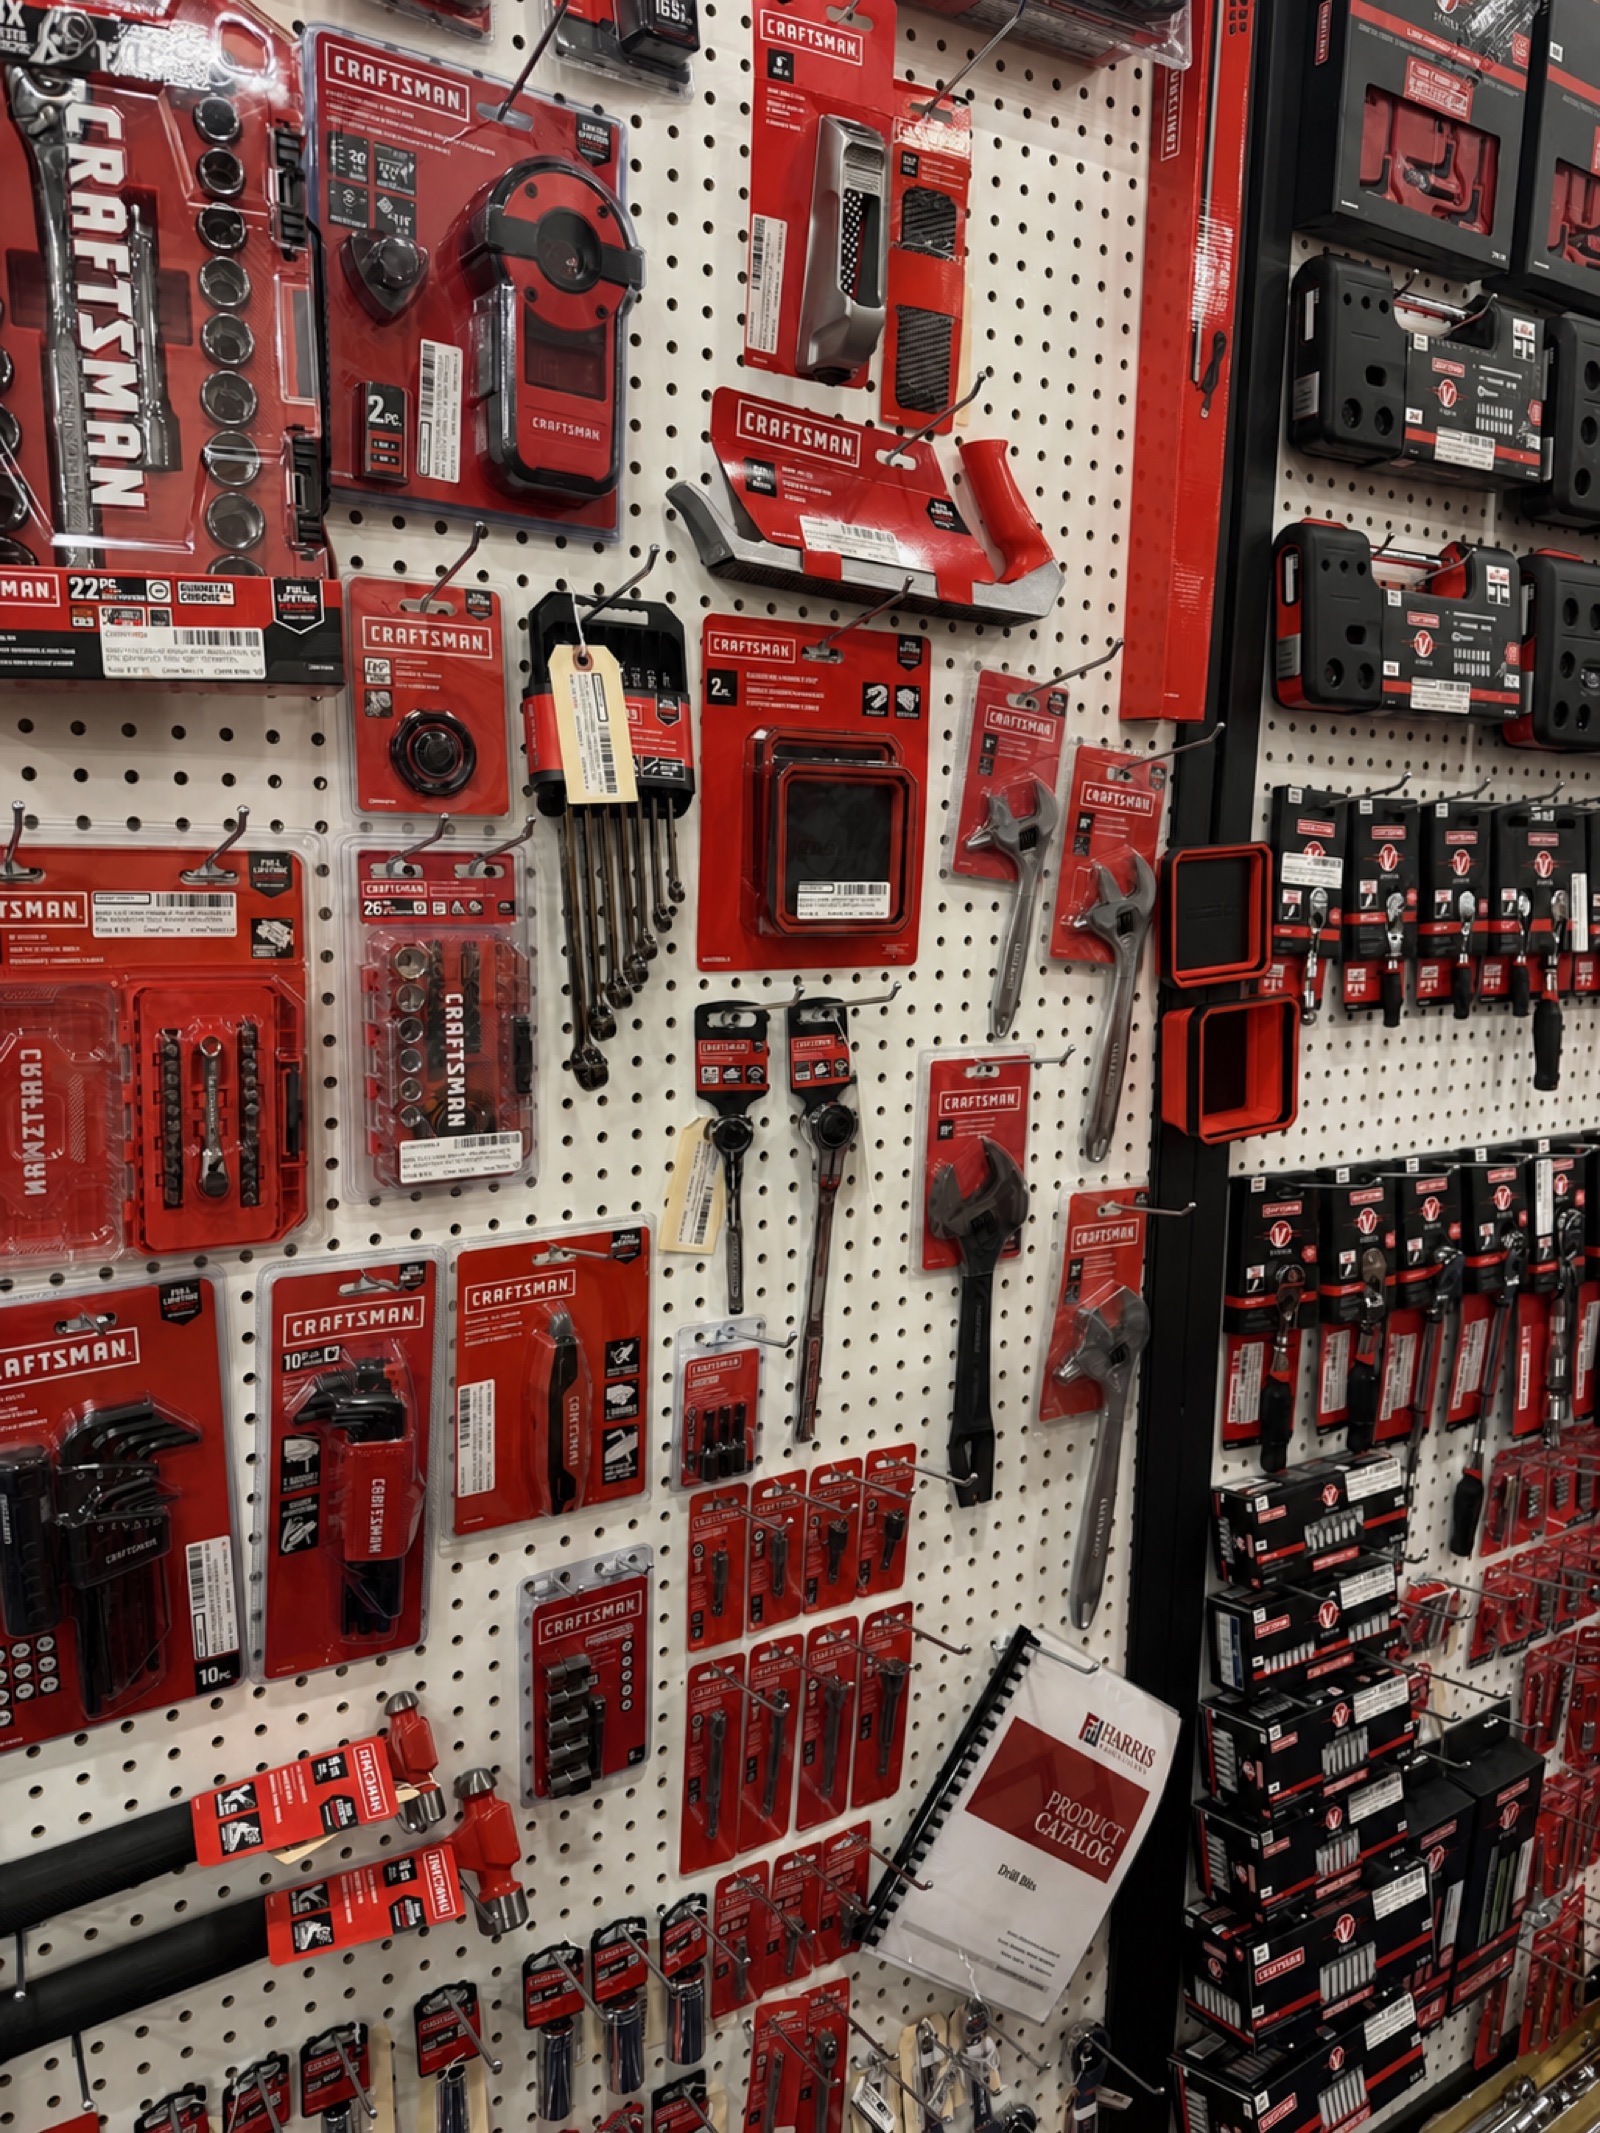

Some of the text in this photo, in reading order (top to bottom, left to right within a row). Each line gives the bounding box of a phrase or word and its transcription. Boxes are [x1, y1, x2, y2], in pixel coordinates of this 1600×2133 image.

[0, 0, 25, 27] X
[767, 18, 857, 56] CRAFTSMAN
[334, 55, 461, 110] CRAFTSMAN
[65, 103, 146, 508] CRAFTSMAN
[368, 394, 384, 424] 2
[532, 416, 600, 441] CRAFTSMAN
[744, 411, 852, 457] CRAFTSMAN
[69, 577, 99, 599] 22
[371, 626, 483, 651] CRAFTSMAN
[713, 637, 790, 658] CRAFTSMAN
[989, 711, 1050, 735] CRAFTSMAN
[1086, 788, 1150, 811] CRAFTSMAN
[364, 901, 382, 916] 26
[445, 993, 466, 1127] CRAFTSMAN
[944, 1092, 1015, 1110] CRAFTSMAN
[1076, 1226, 1134, 1246] CRAFTSMAN
[472, 1277, 568, 1306] CRAFTSMAN
[292, 1305, 415, 1337] CRAFTSMAN
[0, 1338, 126, 1379] AFTSMAN
[284, 1353, 301, 1371] 10
[545, 1599, 635, 1636] CRAFTSMAN
[199, 1666, 218, 1686] 10
[1101, 1724, 1157, 1769] HARRIS
[1045, 1790, 1126, 1845] PRODUCT
[1033, 1811, 1115, 1867] CATALOG
[997, 1863, 1038, 1893] Drill Bits
